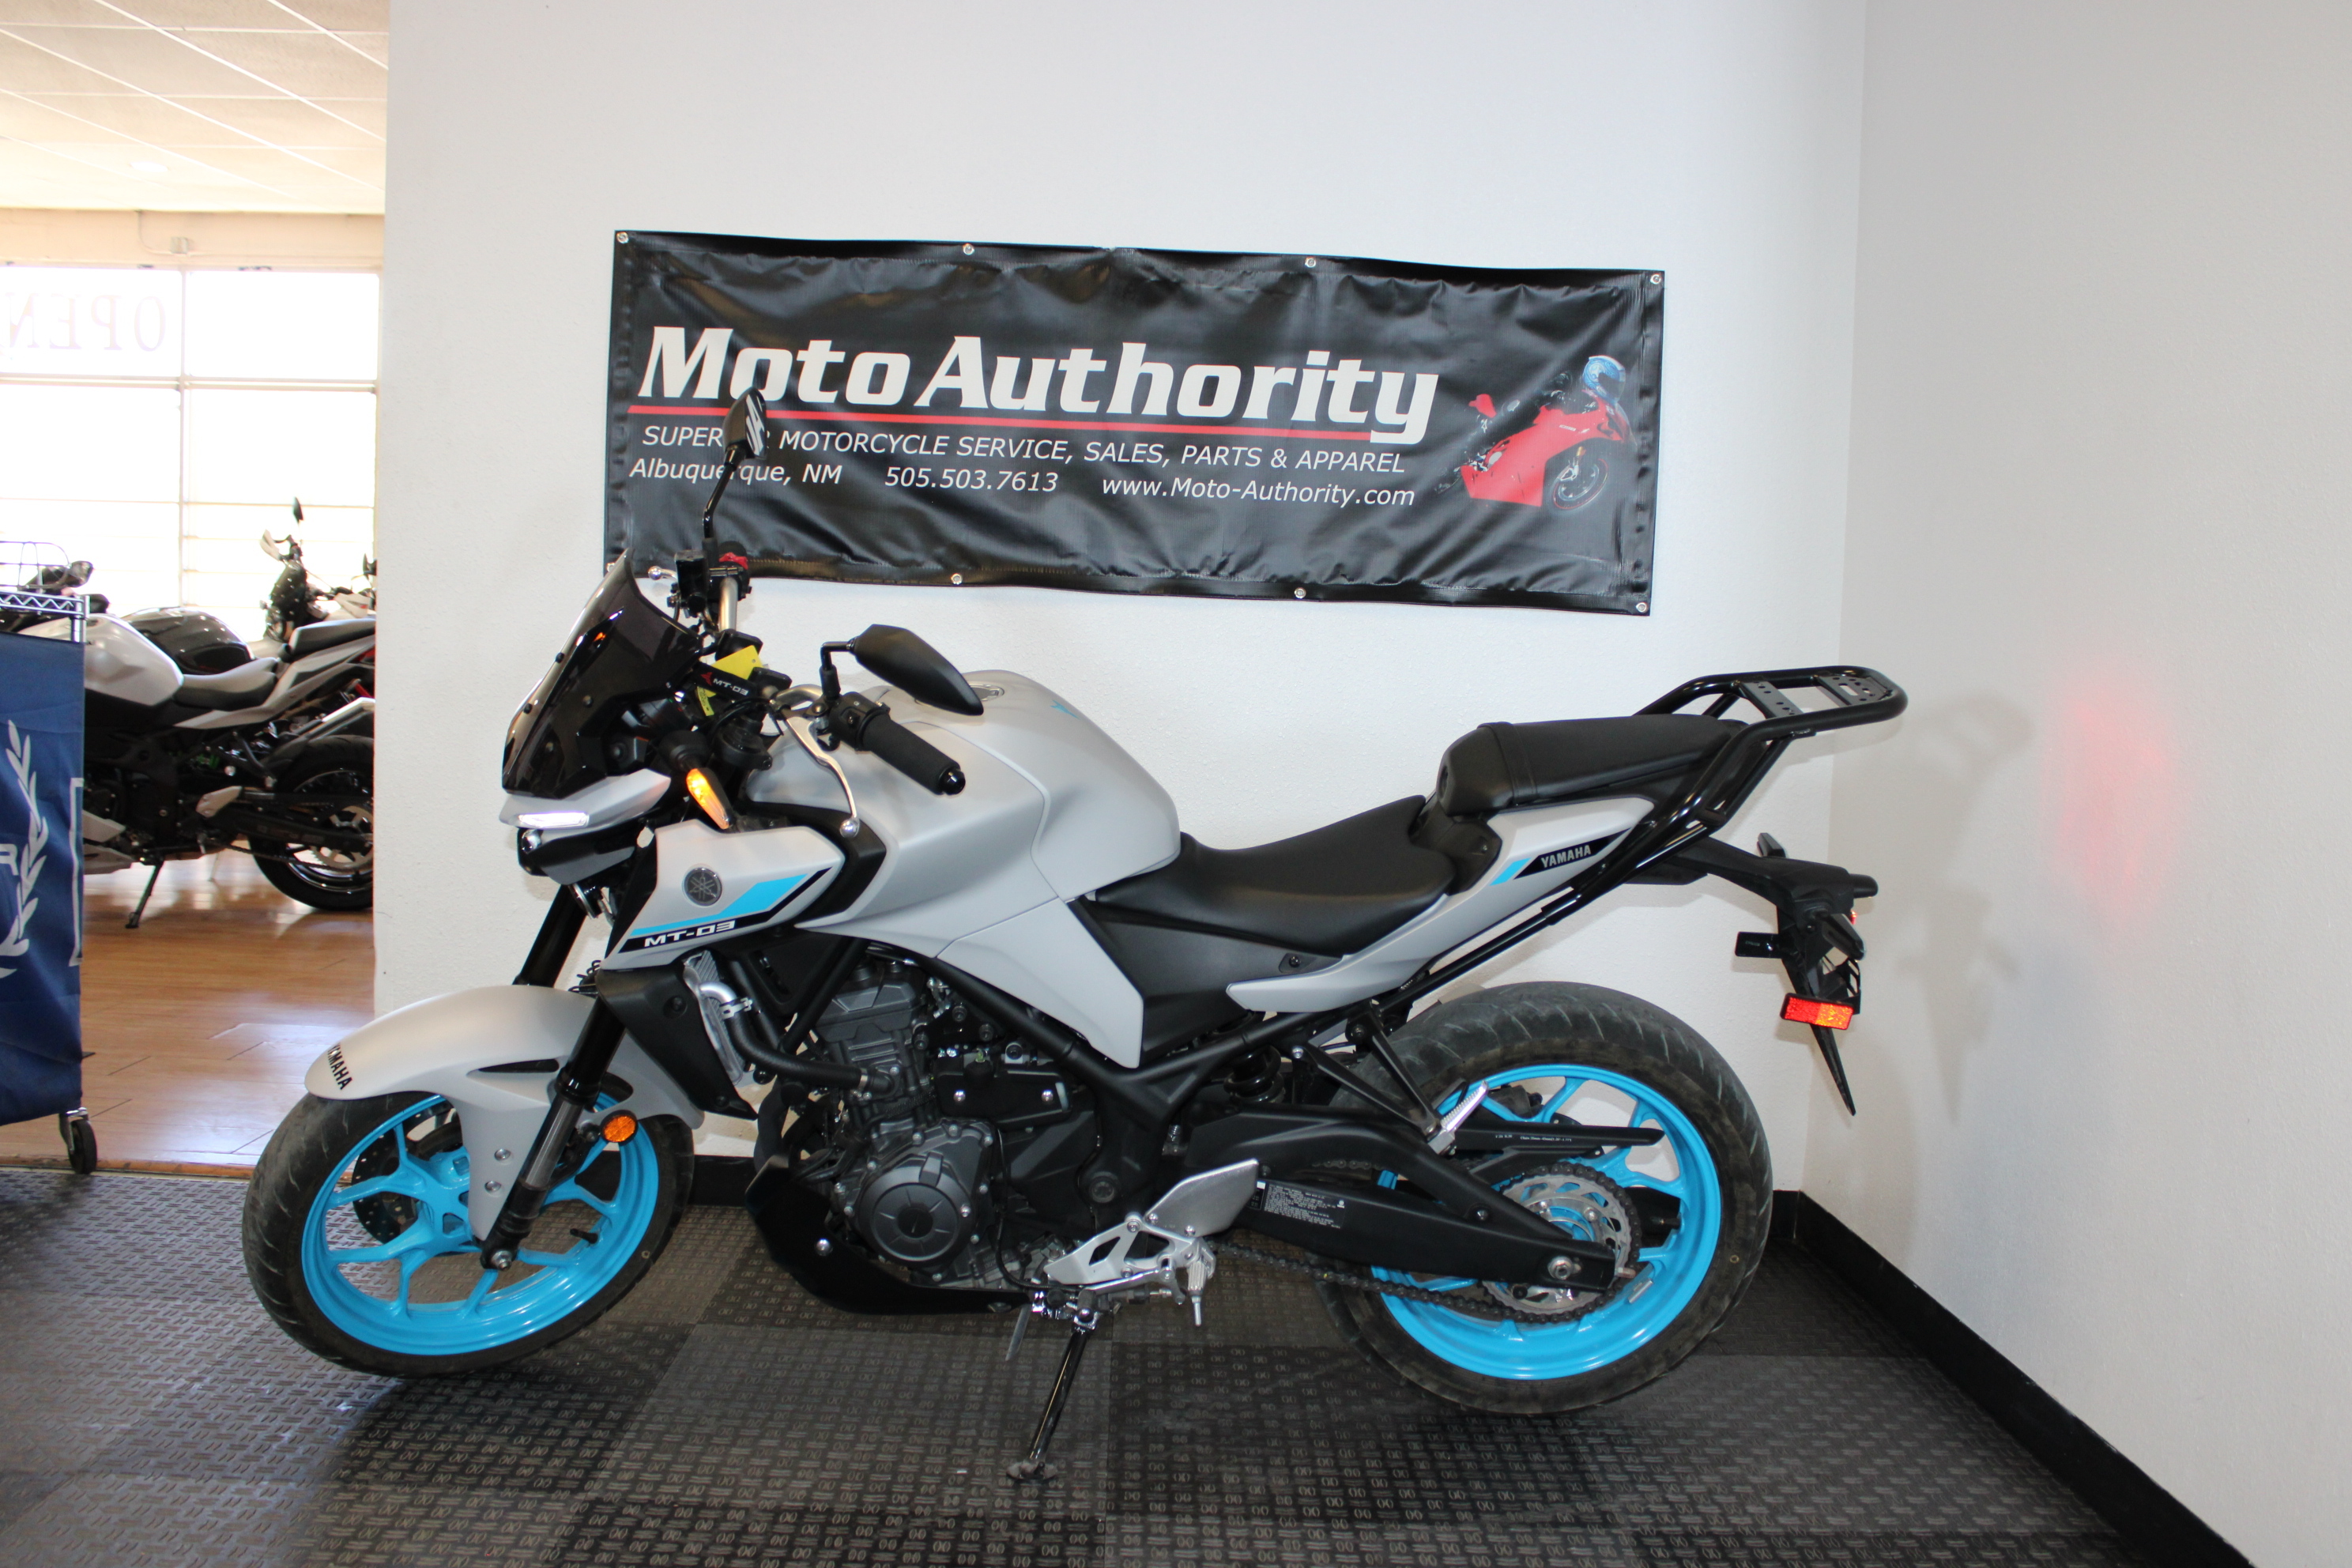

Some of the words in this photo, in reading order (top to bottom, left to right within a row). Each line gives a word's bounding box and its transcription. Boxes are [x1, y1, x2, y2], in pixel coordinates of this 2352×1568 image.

[637, 326, 911, 406] Moto
[913, 335, 1439, 446] Authority
[778, 430, 950, 455] MOTORCYCLE
[956, 435, 1073, 465] SERVICE,
[1084, 441, 1170, 468] SALES,
[1181, 445, 1263, 467] PARTS
[1270, 448, 1287, 469] &
[1294, 449, 1405, 473] APPAREL
[802, 463, 842, 484] NM
[884, 466, 1059, 492] 505.503.7613
[1102, 477, 1415, 508] www.Moto-Authority.com
[712, 678, 749, 696] MT-03
[1540, 844, 1592, 869] YAMAHA
[644, 920, 736, 948] MT-03
